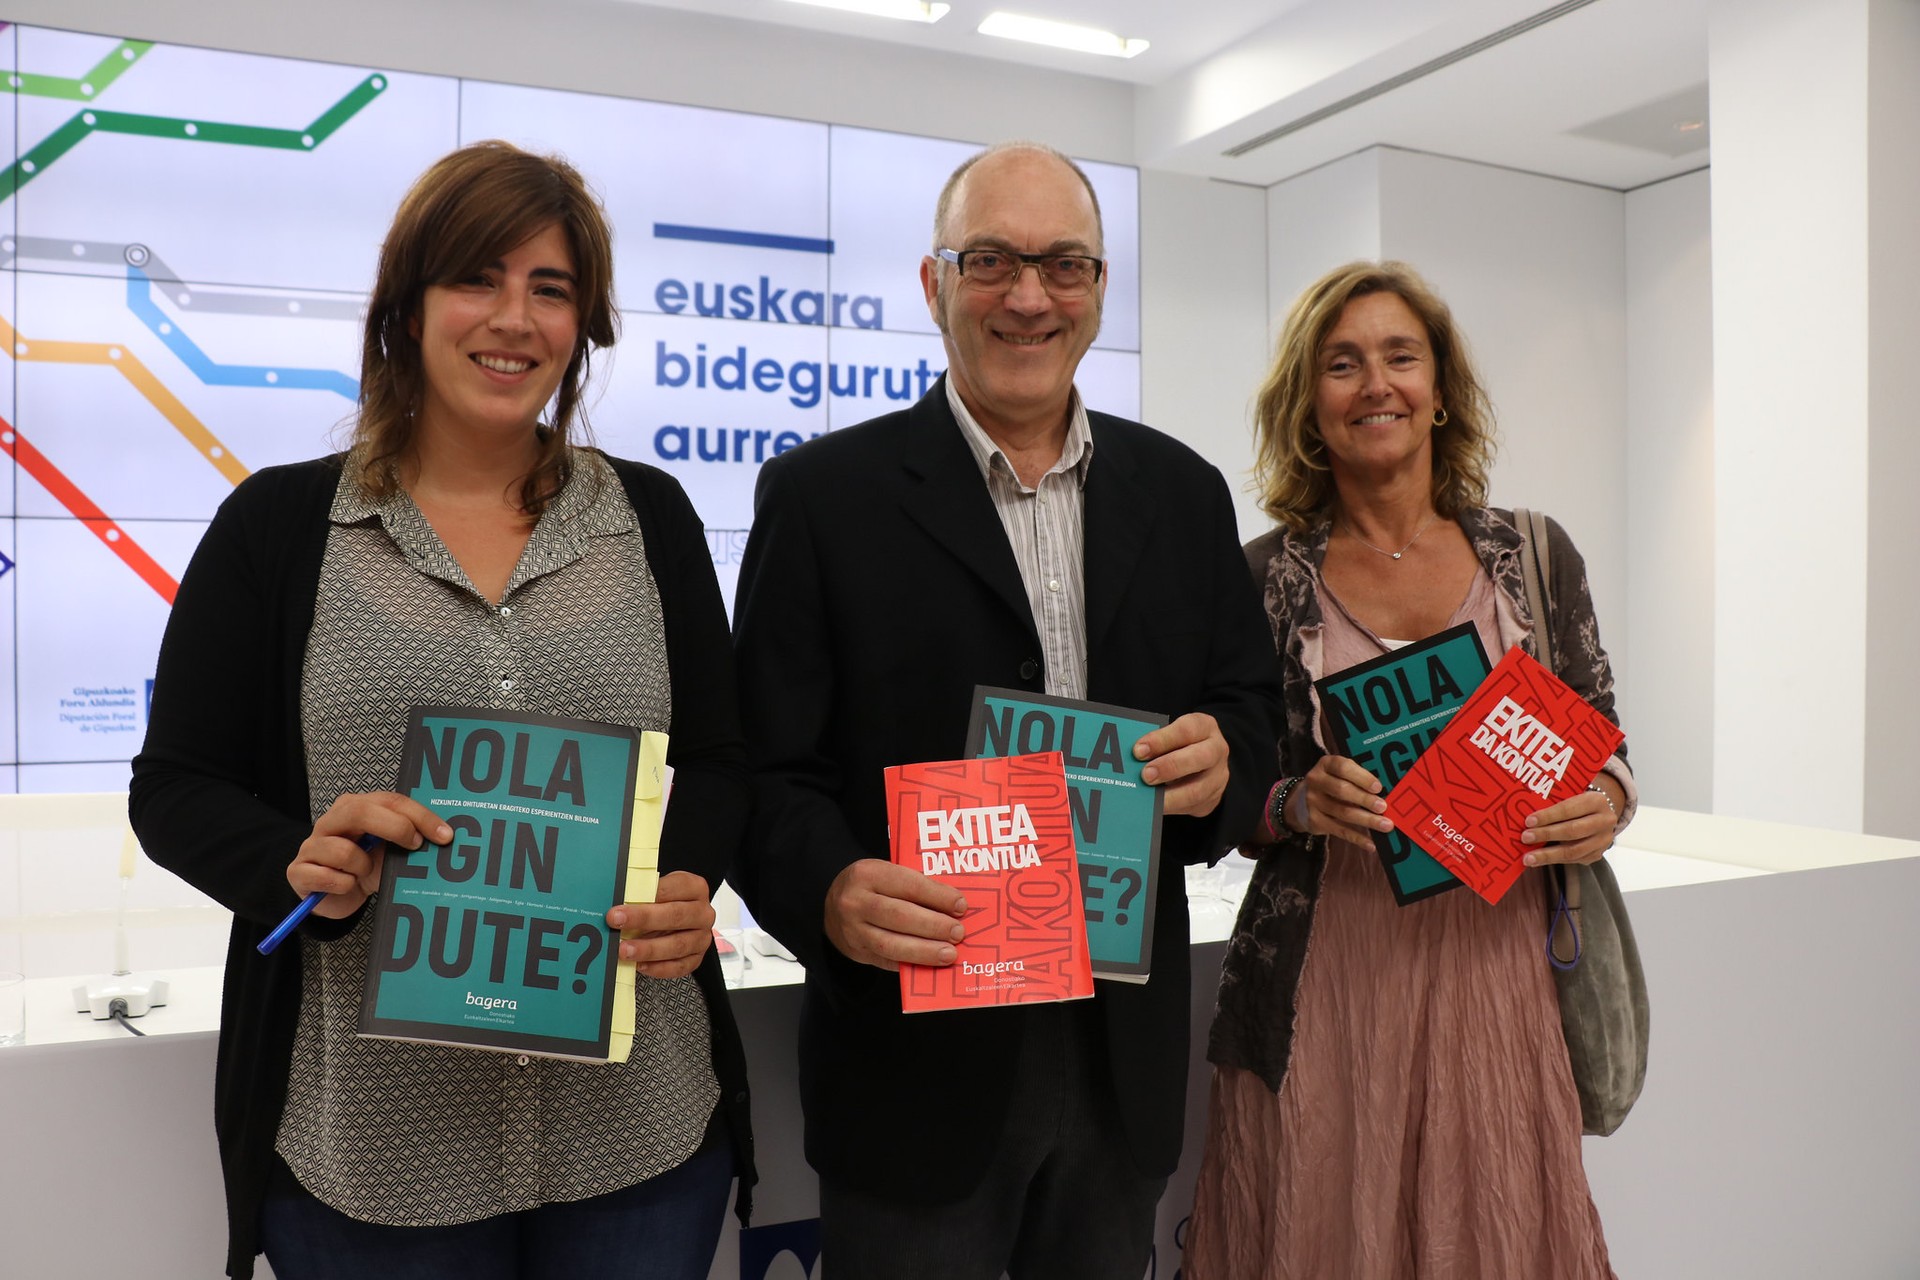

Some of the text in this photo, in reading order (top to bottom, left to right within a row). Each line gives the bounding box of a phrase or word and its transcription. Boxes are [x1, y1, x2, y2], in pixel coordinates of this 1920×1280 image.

[655, 276, 883, 330] euskara
[653, 425, 829, 463] aurre
[1329, 654, 1464, 739] NOLA
[976, 704, 1125, 774] NOLA
[1469, 724, 1554, 800] DA KONTUA
[1483, 695, 1575, 782] EKITEA
[412, 727, 586, 806] NOLA
[1078, 775, 1115, 786] ESPERIENTZIEN
[1115, 780, 1136, 788] BILDUMA
[462, 801, 498, 810] OHITURETAN
[499, 804, 530, 813] ERAGITEKO
[531, 808, 573, 820] ESPERIENTZIEN
[574, 815, 599, 824] BILDUMA
[917, 803, 1038, 851] EKITEA
[1432, 814, 1475, 853] bagera
[922, 850, 952, 876] DA
[954, 844, 1042, 875] KONTUA
[381, 903, 603, 995] DUTE?
[963, 961, 1025, 977] bagera
[465, 991, 517, 1010] bagera
